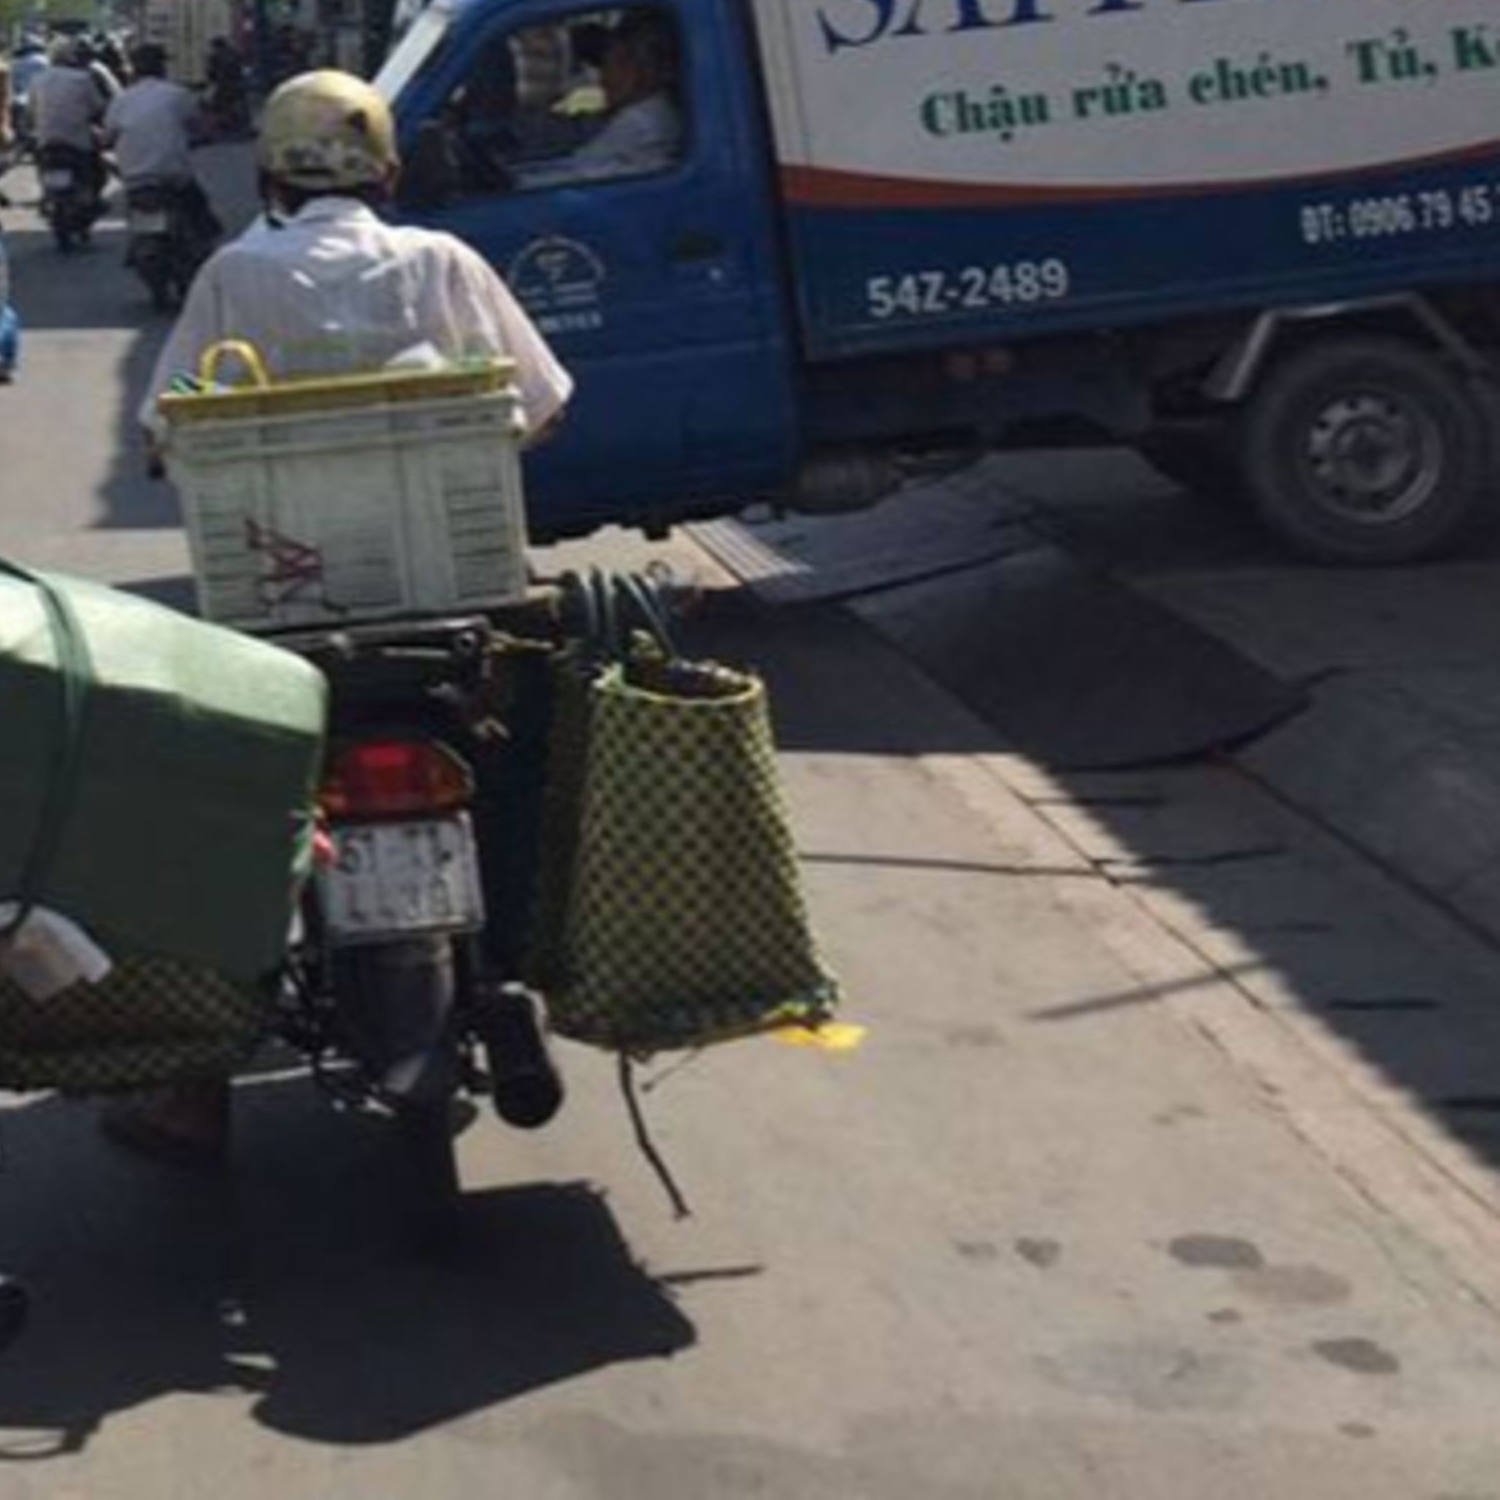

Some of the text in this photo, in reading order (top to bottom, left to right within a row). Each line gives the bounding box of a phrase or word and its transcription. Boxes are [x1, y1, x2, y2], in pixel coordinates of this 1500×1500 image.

[920, 83, 1051, 142] Chậu
[1072, 61, 1168, 118] rửa
[866, 257, 1070, 318] 54Z-2489
